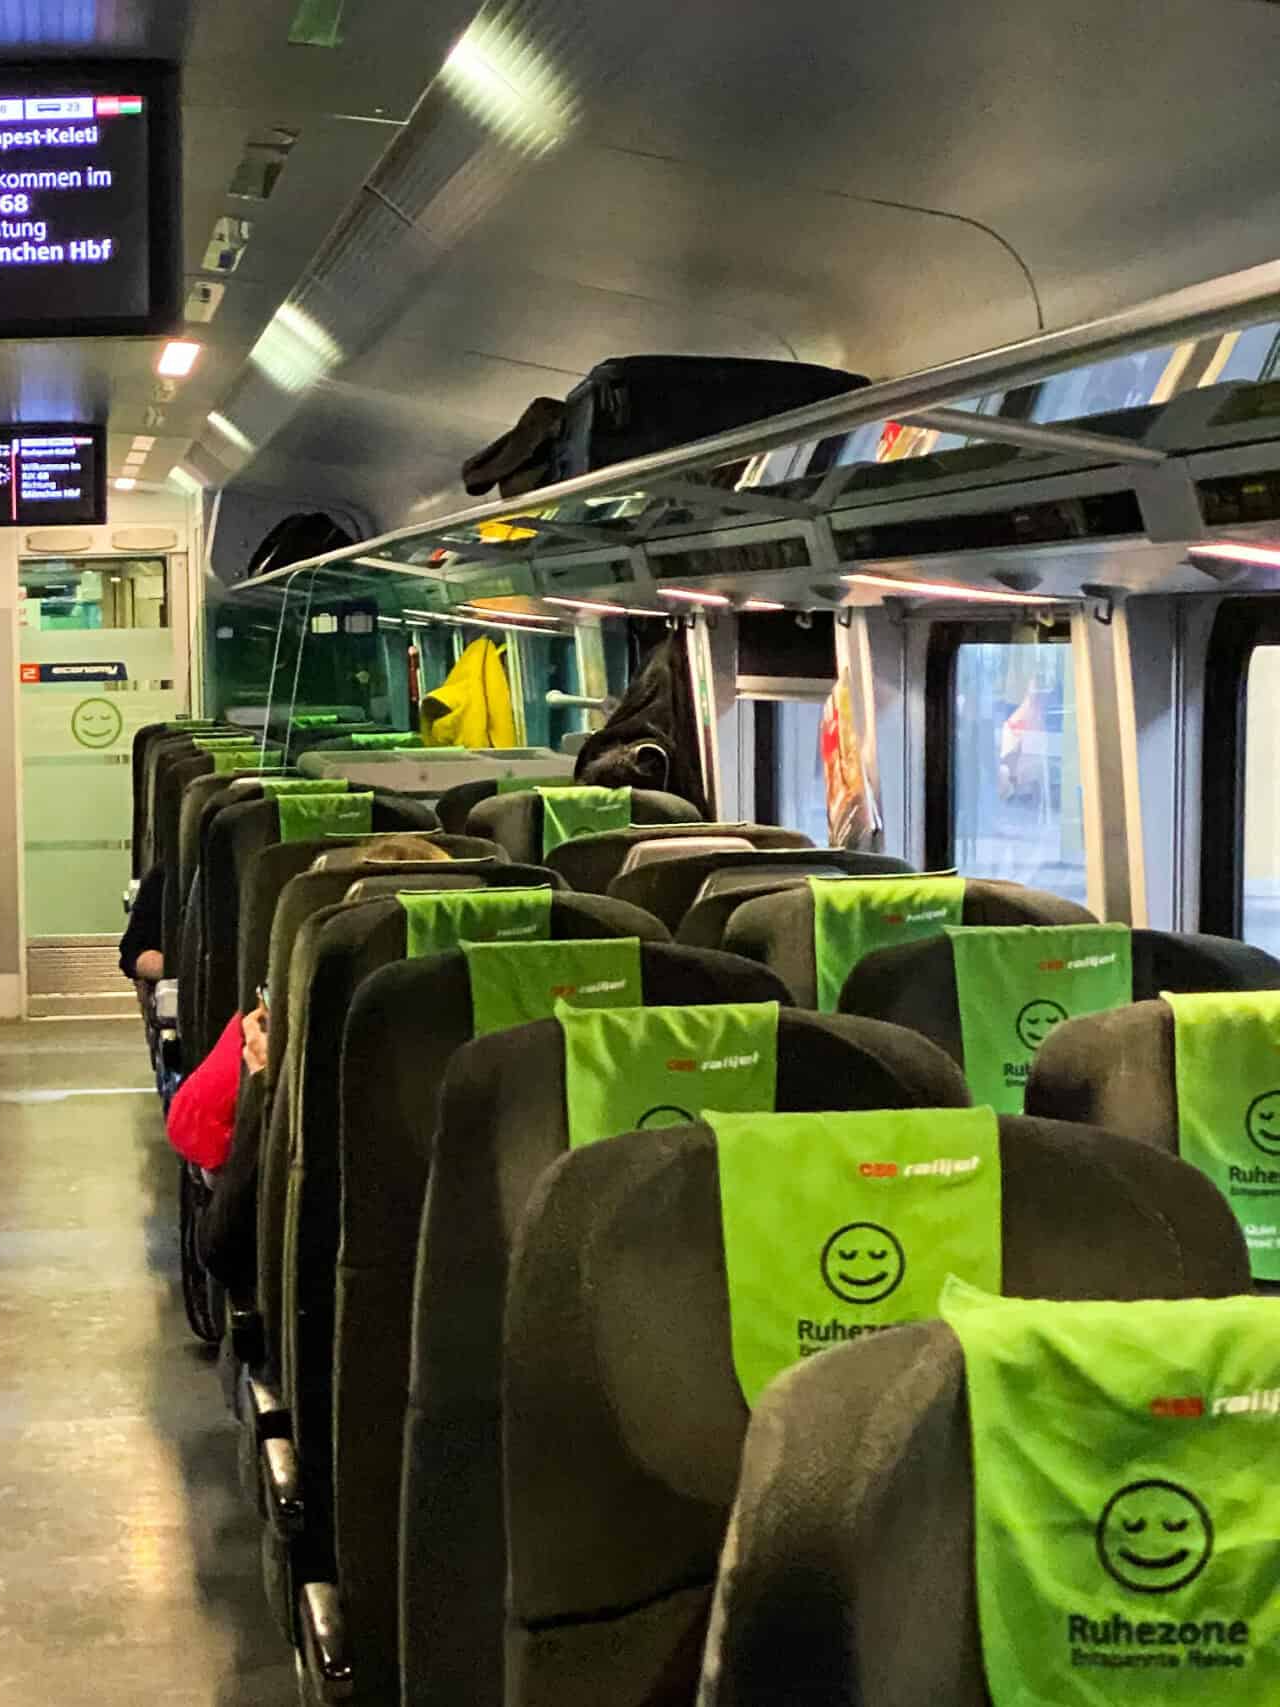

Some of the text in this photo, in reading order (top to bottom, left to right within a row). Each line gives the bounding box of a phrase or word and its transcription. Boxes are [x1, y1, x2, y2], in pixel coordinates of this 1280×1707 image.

[86, 166, 113, 186] im
[0, 193, 29, 214] 68
[70, 239, 112, 261] Hbf
[1067, 1614, 1250, 1645] Ruhezone
